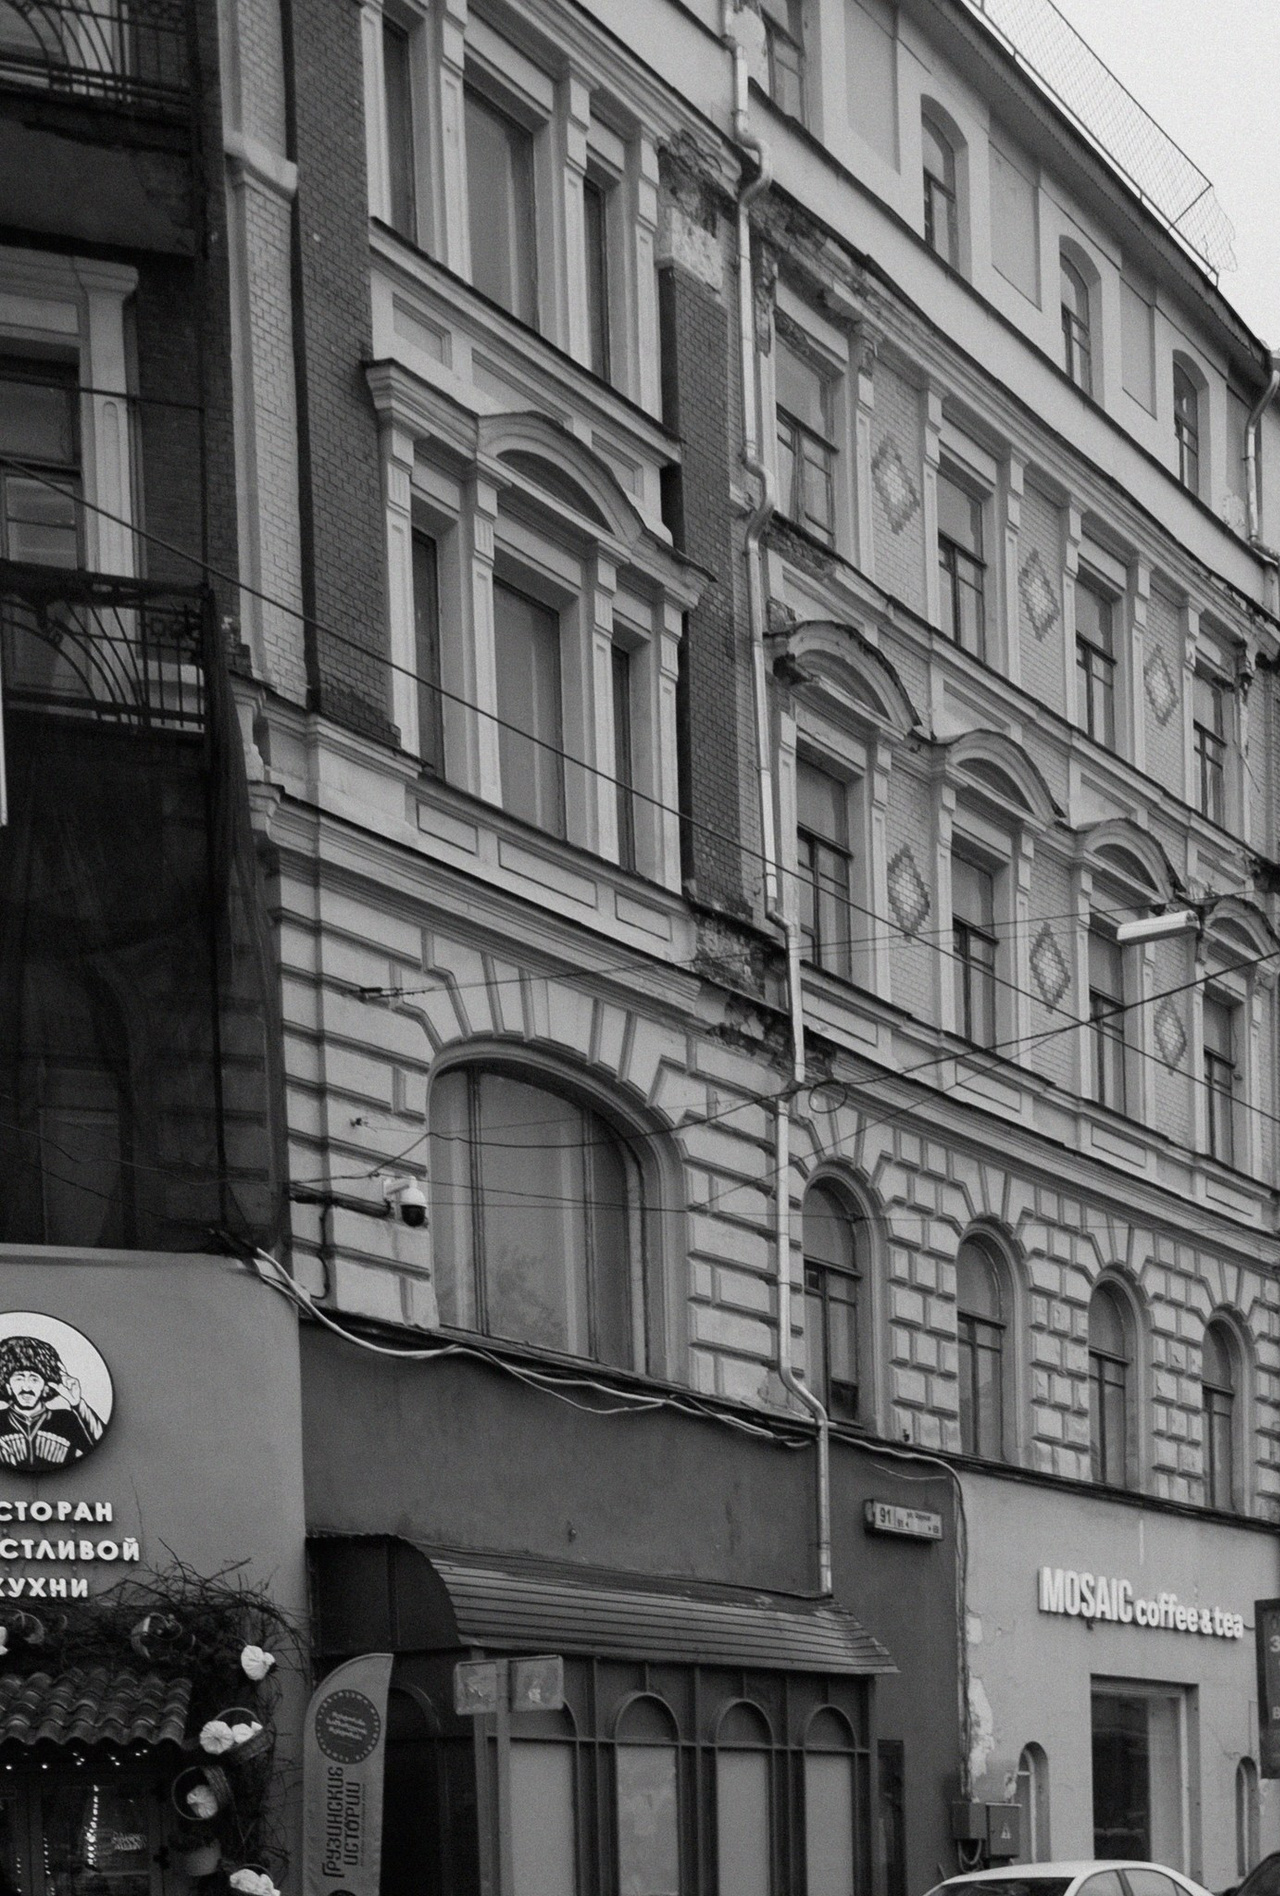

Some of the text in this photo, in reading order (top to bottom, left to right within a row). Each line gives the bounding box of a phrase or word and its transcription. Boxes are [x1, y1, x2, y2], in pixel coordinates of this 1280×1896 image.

[880, 1507, 891, 1524] 91
[0, 1537, 140, 1561] СТЛИВОЙ
[1039, 1566, 1244, 1639] MOSAIC coffee & tea
